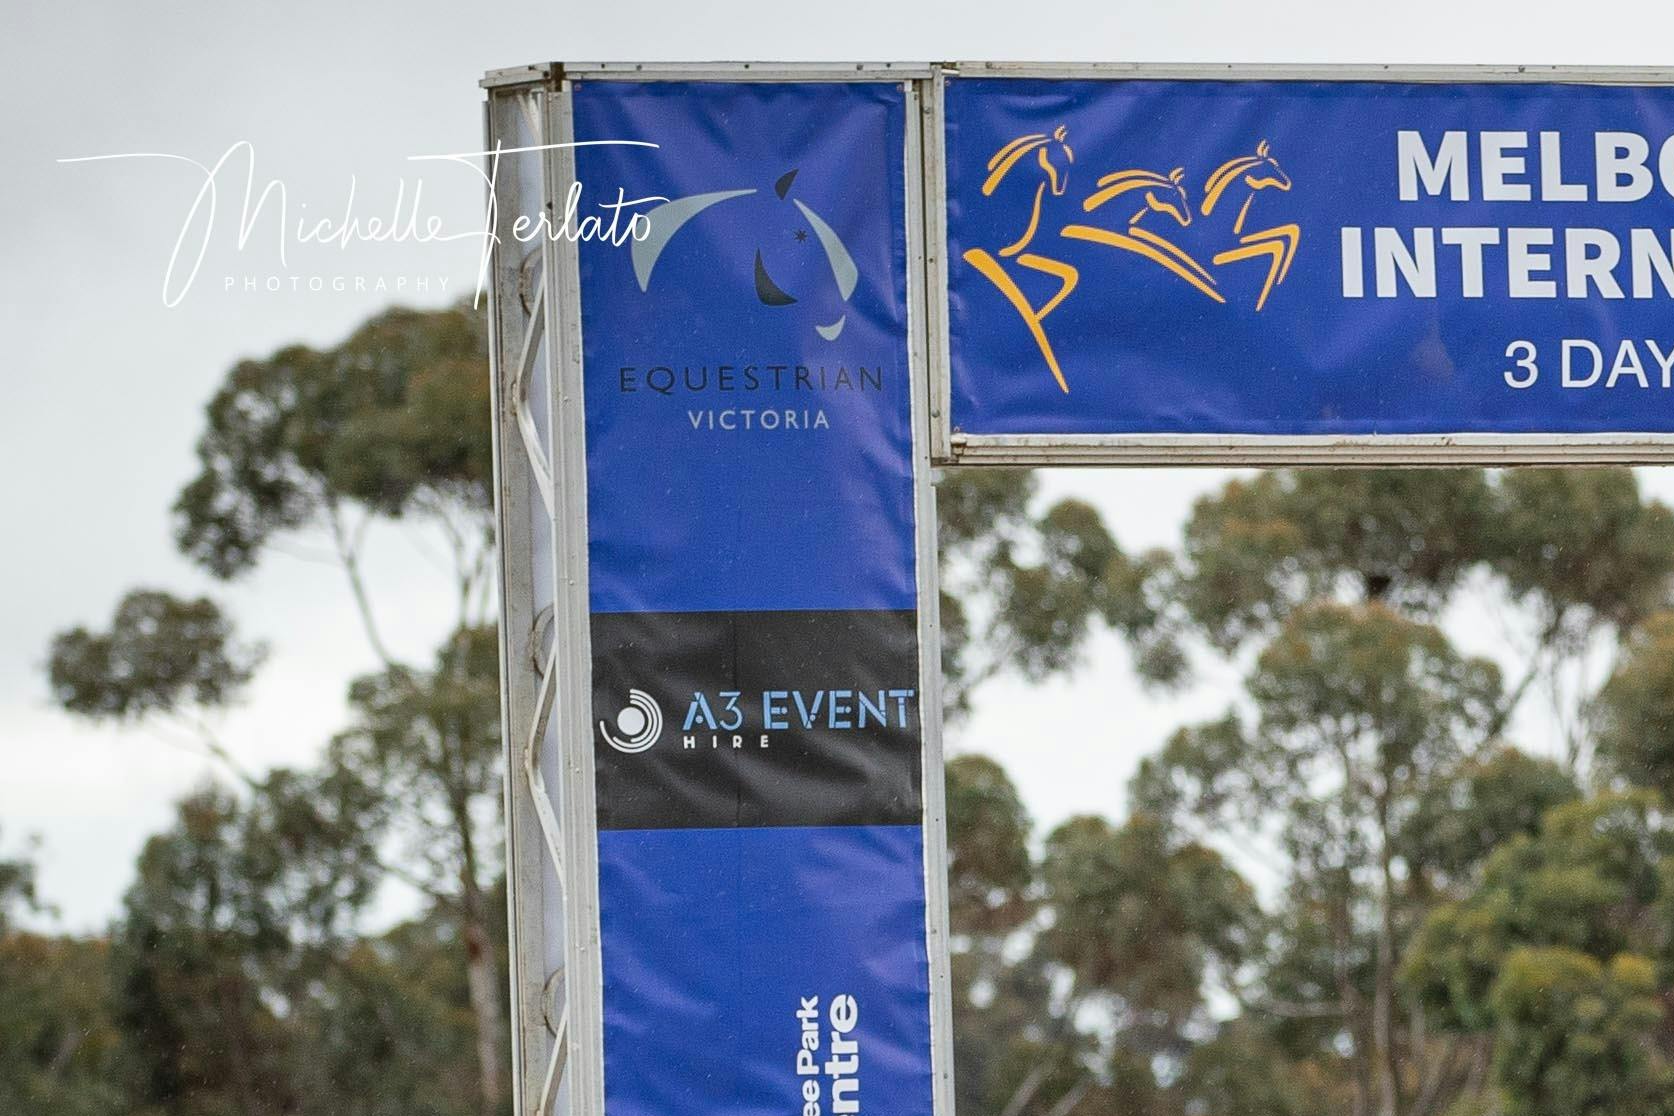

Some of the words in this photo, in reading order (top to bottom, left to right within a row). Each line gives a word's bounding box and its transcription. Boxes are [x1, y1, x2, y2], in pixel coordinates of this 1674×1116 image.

[619, 365, 883, 396] EQUESTRIAN
[1503, 340, 1539, 389] 3
[687, 408, 830, 430] VICTORIA
[682, 691, 743, 731] A3
[763, 689, 915, 730] EVENT
[683, 734, 769, 749] HIRE
[796, 995, 820, 1076] Park
